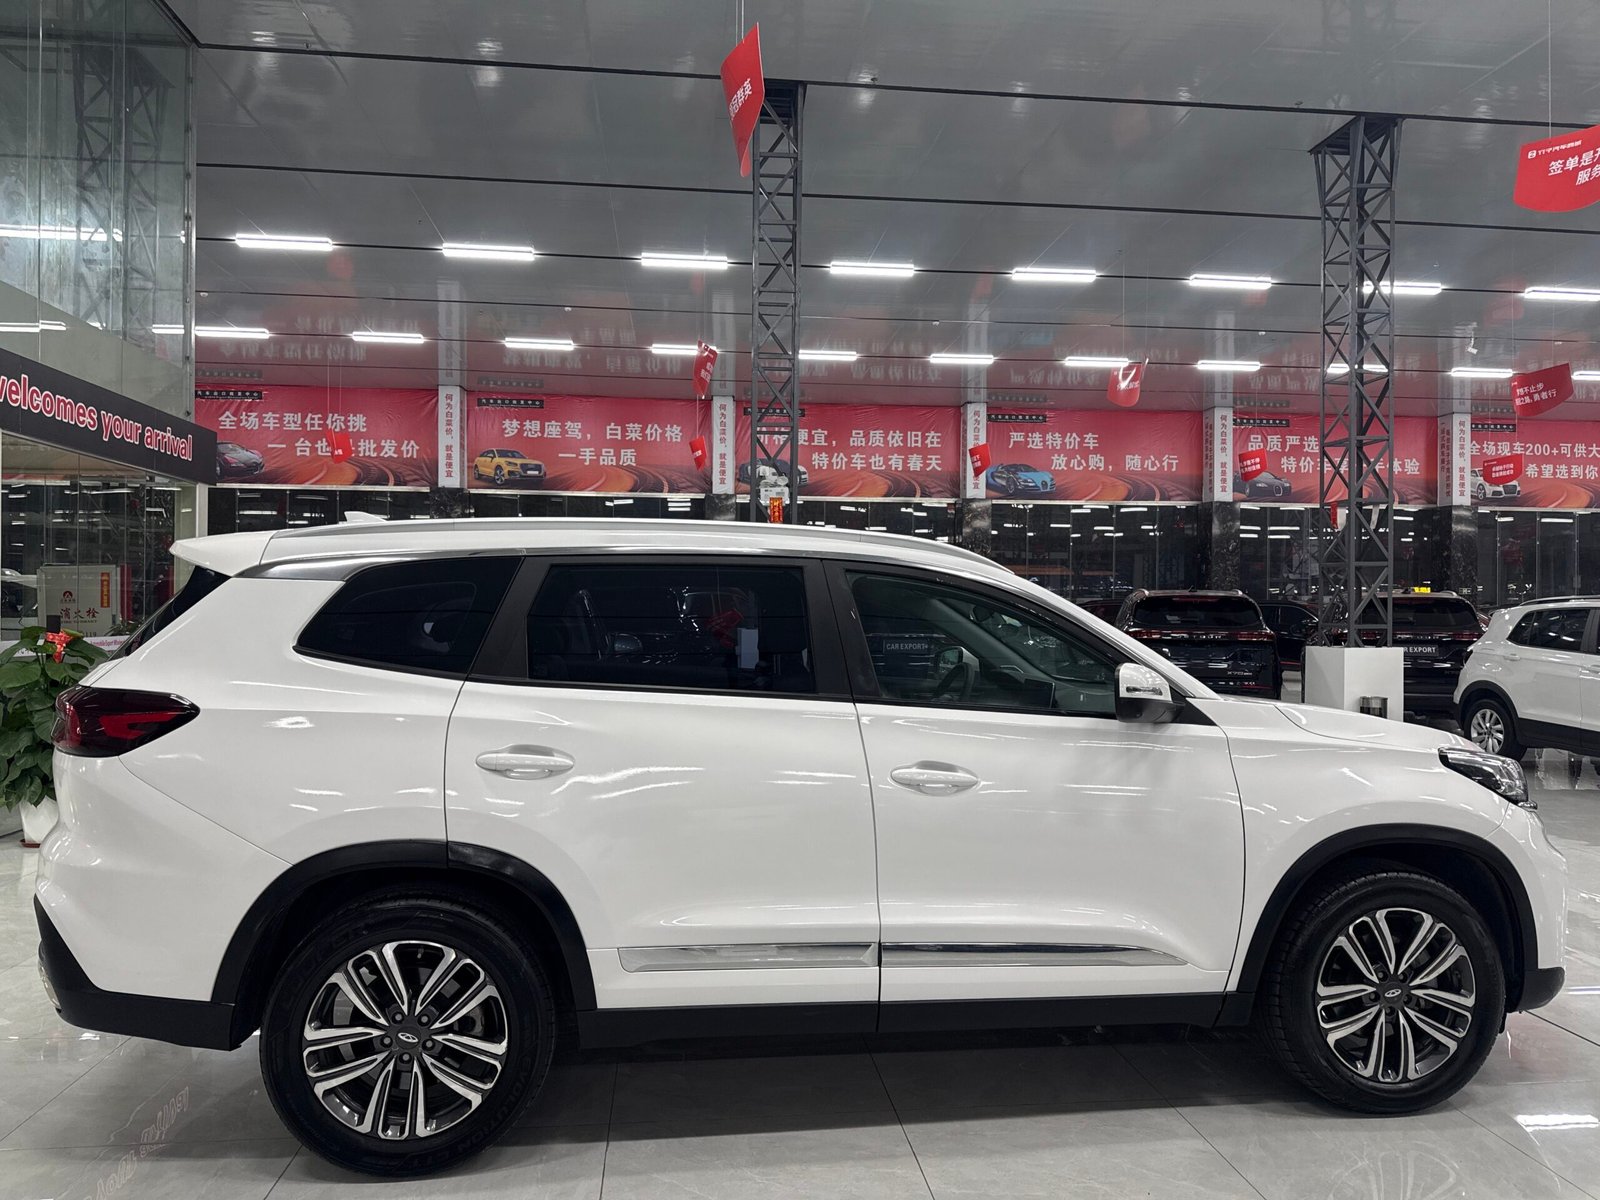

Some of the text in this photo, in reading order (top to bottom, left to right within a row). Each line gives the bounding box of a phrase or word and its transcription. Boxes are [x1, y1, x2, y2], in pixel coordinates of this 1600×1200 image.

[218, 411, 367, 432] 全场车型任你挑
[502, 418, 683, 442] 梦想座驾，白菜价格
[100, 410, 142, 445] your
[144, 426, 193, 462] arrival
[719, 403, 727, 485] 何为白菜价，就是便宜
[1008, 431, 1099, 449] 严选特价车
[1248, 434, 1319, 453] 品质严选
[267, 437, 420, 459] 一台也批发价
[558, 448, 637, 466] 一手品质
[1220, 414, 1228, 493] 何为白菜价，就是便宜
[812, 453, 942, 471] 特价车也有春天
[1051, 453, 1179, 471] 放心购，随心行
[1525, 463, 1599, 480] 希望选到你
